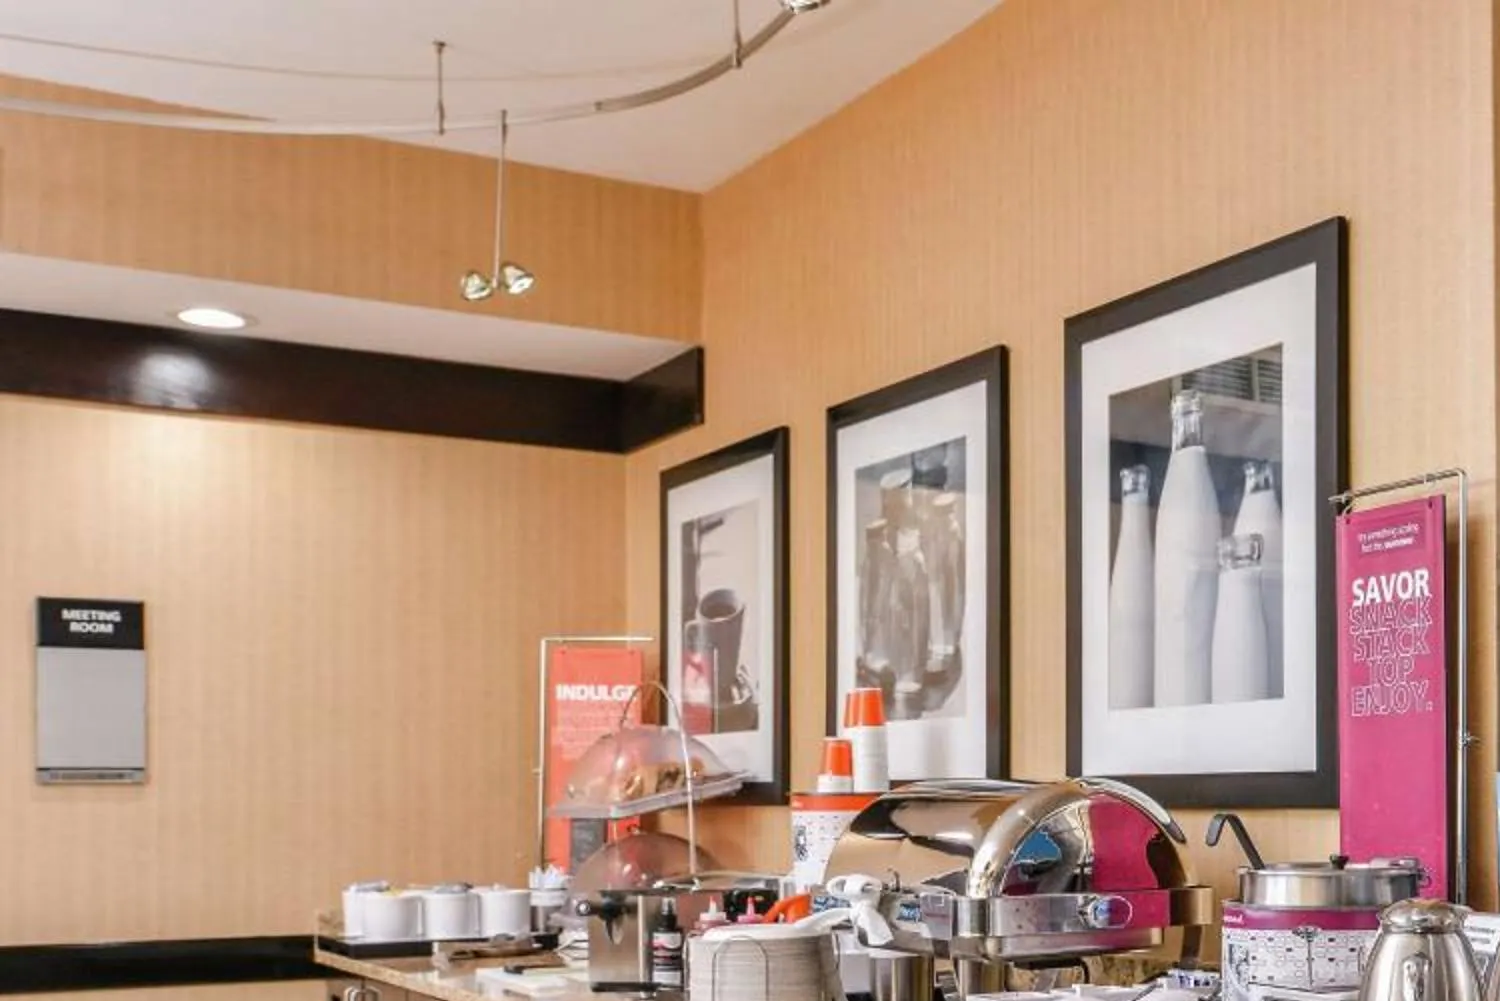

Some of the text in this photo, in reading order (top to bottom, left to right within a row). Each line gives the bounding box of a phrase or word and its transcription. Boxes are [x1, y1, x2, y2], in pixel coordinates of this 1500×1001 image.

[1352, 568, 1431, 607] SAVOR
[61, 607, 122, 622] MEETING
[69, 621, 114, 633] ROOM
[1350, 594, 1433, 634] SNACK
[1353, 625, 1431, 662] STACK
[1368, 653, 1415, 687] TOP
[1351, 680, 1433, 717] ENJOY.
